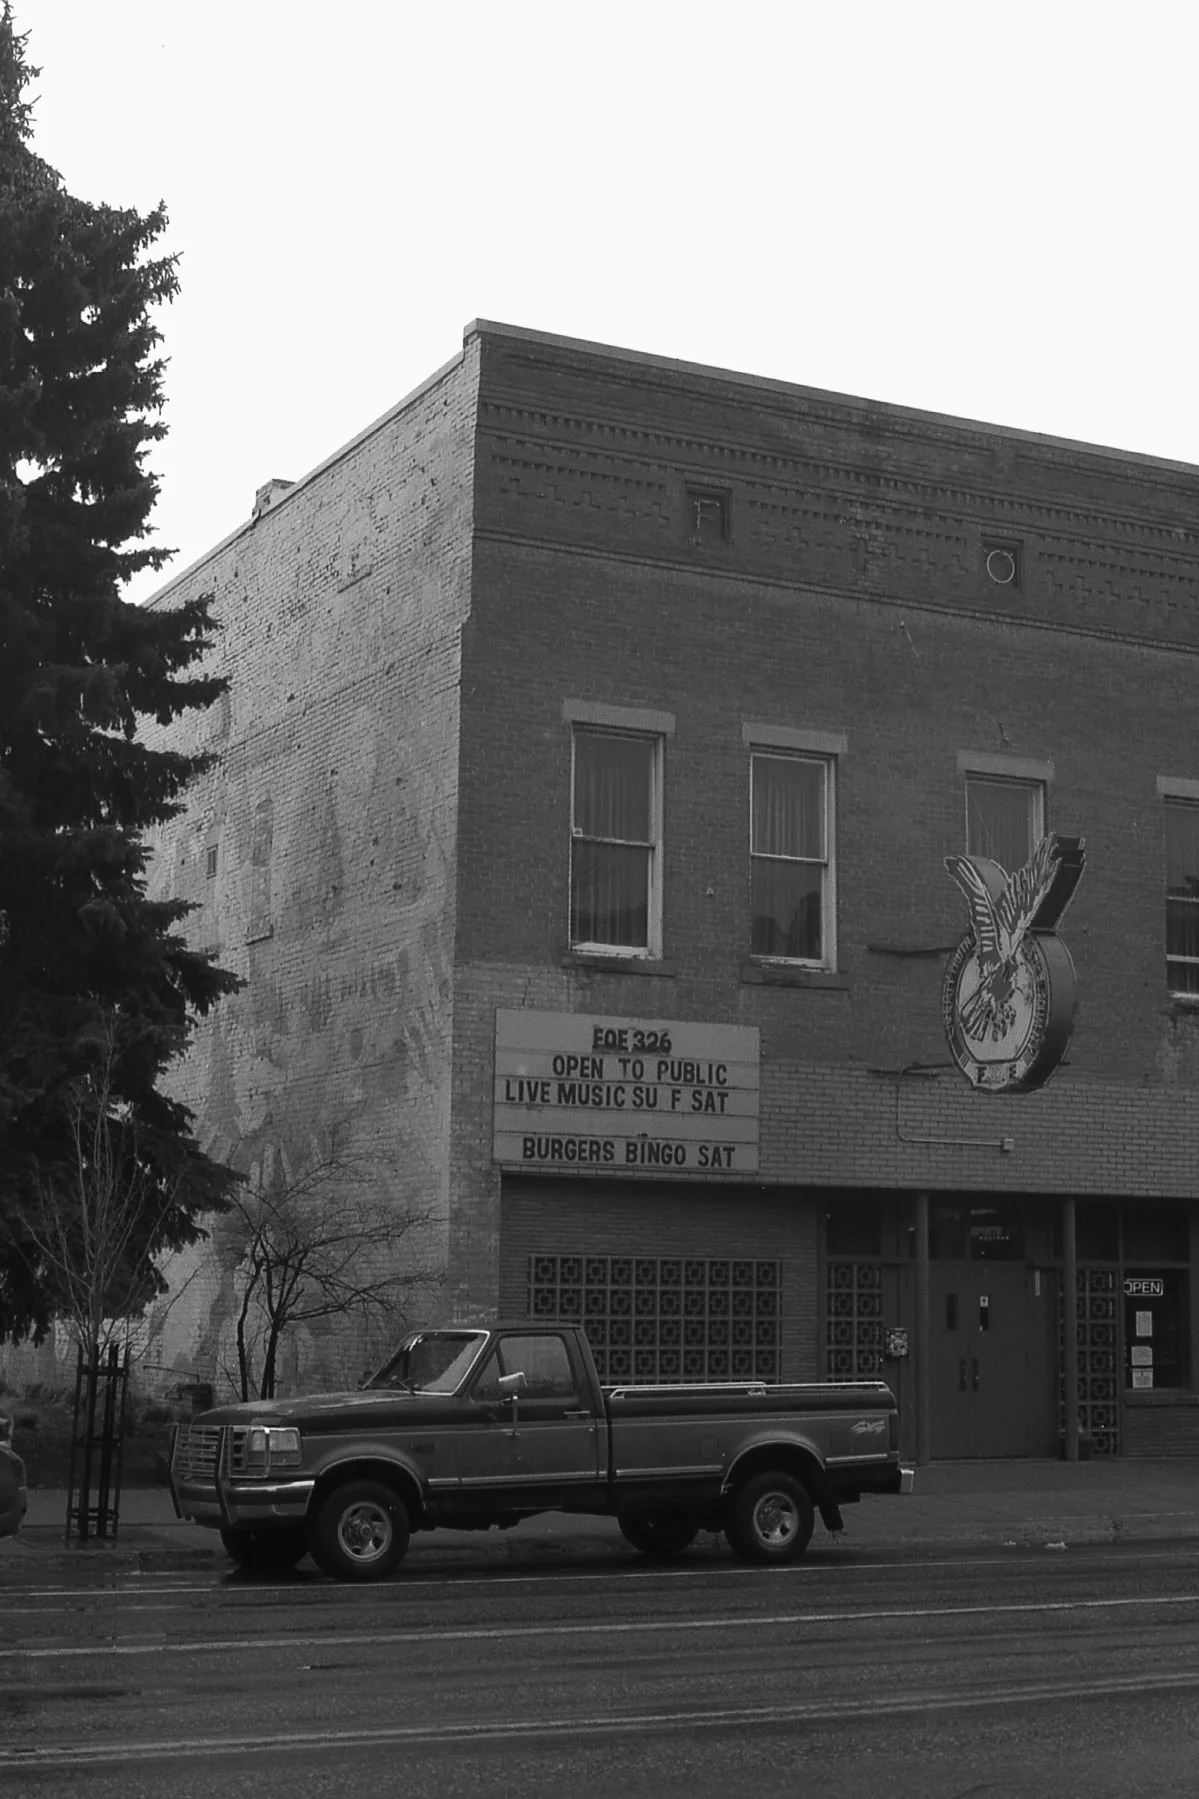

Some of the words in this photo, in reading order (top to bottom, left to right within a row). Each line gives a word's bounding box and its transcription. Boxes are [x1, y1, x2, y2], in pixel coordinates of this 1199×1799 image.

[633, 1030, 672, 1054] 326
[552, 1055, 604, 1080] OPEN
[618, 1058, 644, 1080] TO
[657, 1060, 728, 1085] PUBLIC
[505, 1079, 551, 1103] LIVE
[557, 1083, 626, 1108] MUSIC
[632, 1086, 658, 1109] SU
[671, 1089, 682, 1110] F
[691, 1090, 729, 1113] SAT
[522, 1136, 614, 1162] BURGERS
[625, 1141, 687, 1166] BINGO
[698, 1145, 736, 1168] SAT
